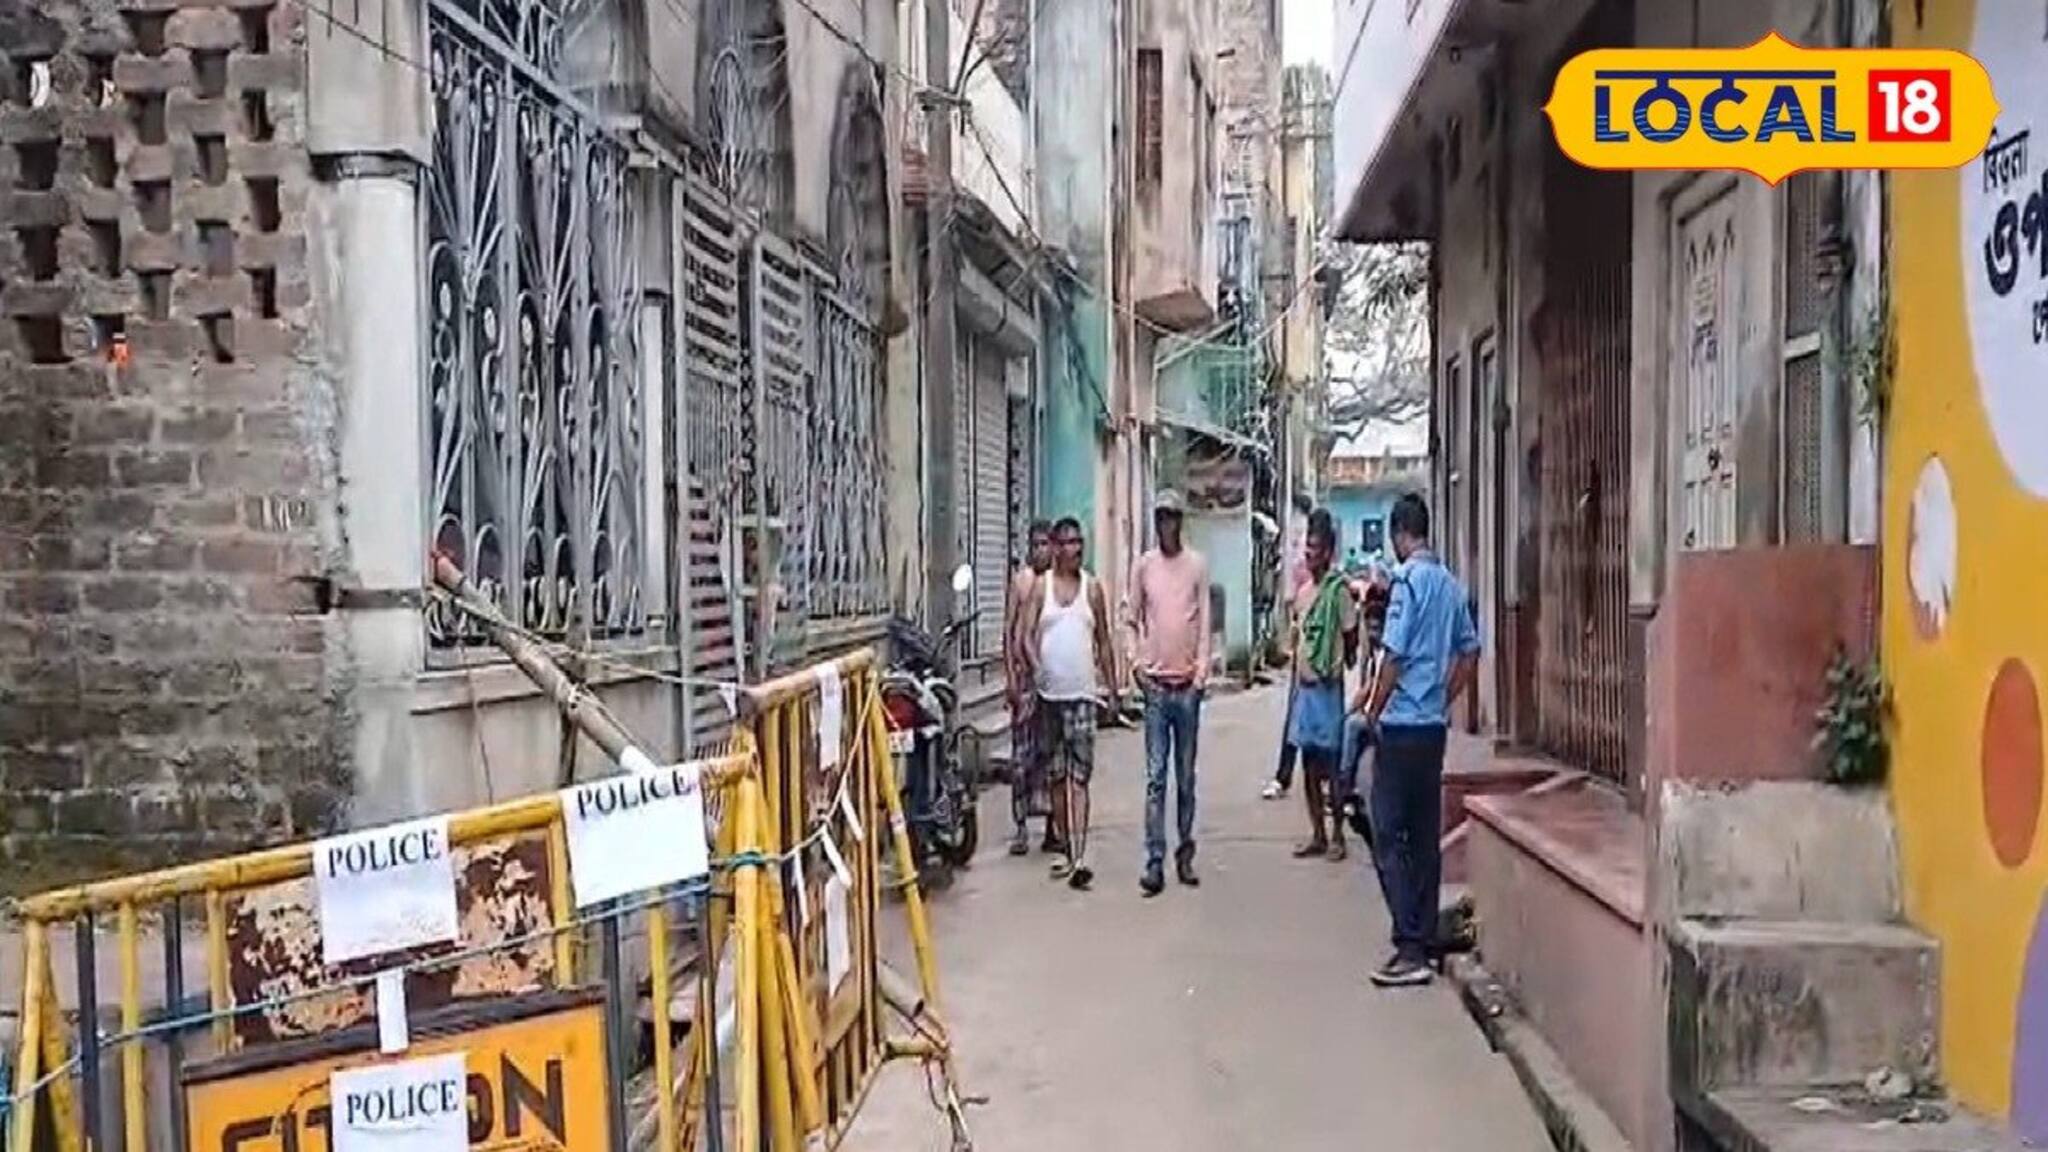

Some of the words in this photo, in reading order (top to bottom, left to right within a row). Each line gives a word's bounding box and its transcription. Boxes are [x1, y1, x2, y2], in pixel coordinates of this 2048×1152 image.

[577, 770, 693, 820] POLICE
[328, 829, 442, 878] POLICE
[346, 1079, 459, 1124] POLICE
